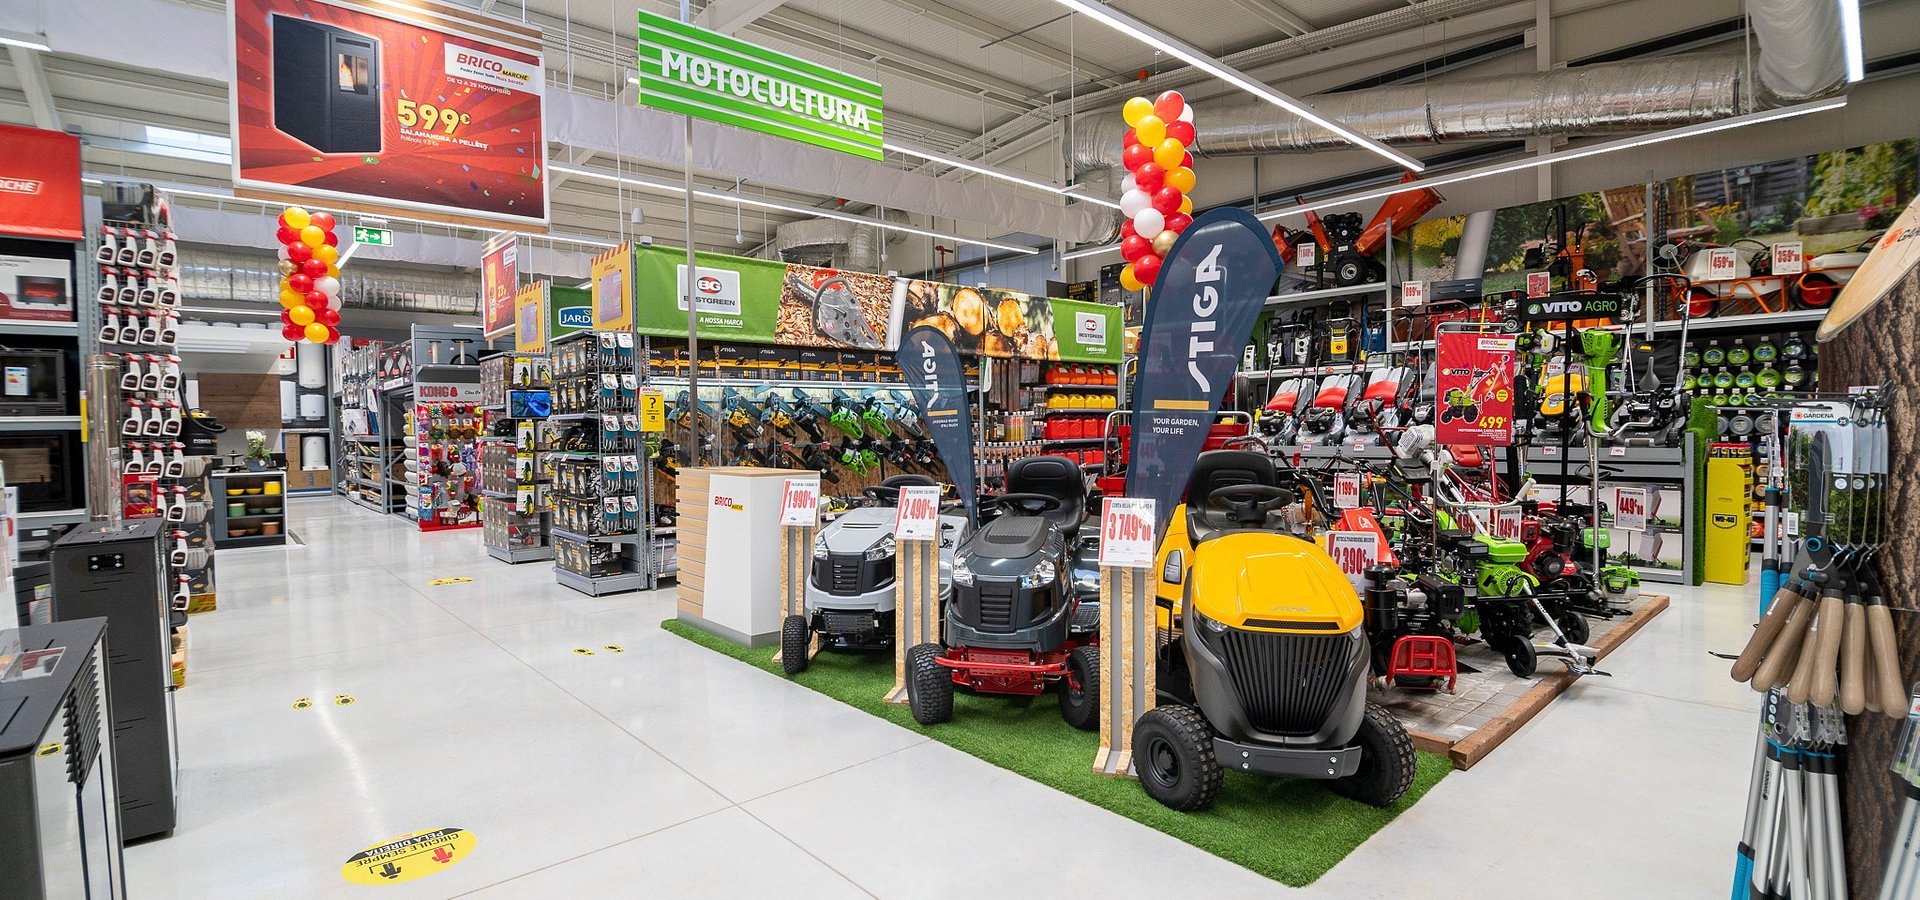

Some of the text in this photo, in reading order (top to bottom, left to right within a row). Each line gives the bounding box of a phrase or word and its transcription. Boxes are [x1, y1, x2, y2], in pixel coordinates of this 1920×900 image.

[456, 52, 503, 73] BRICO
[478, 84, 511, 95] NOVEMBRO
[661, 49, 870, 131] MOTOCULTURA
[397, 99, 471, 134] 599€
[400, 128, 450, 142] SALAMANDRA
[699, 280, 721, 290] BG
[683, 295, 735, 306] BSTGREEN
[1542, 301, 1617, 313] VITO AGRO
[704, 317, 723, 325] NOSSA
[723, 318, 743, 326] MARCA
[1188, 244, 1222, 392] STIGA
[420, 386, 449, 397] KONG
[1170, 418, 1200, 427] GARDEN,
[715, 496, 732, 507] BRICO
[413, 831, 444, 843] PELA
[356, 833, 459, 867] CIRCULE SEMPRE
[364, 840, 412, 856] DIREITA
